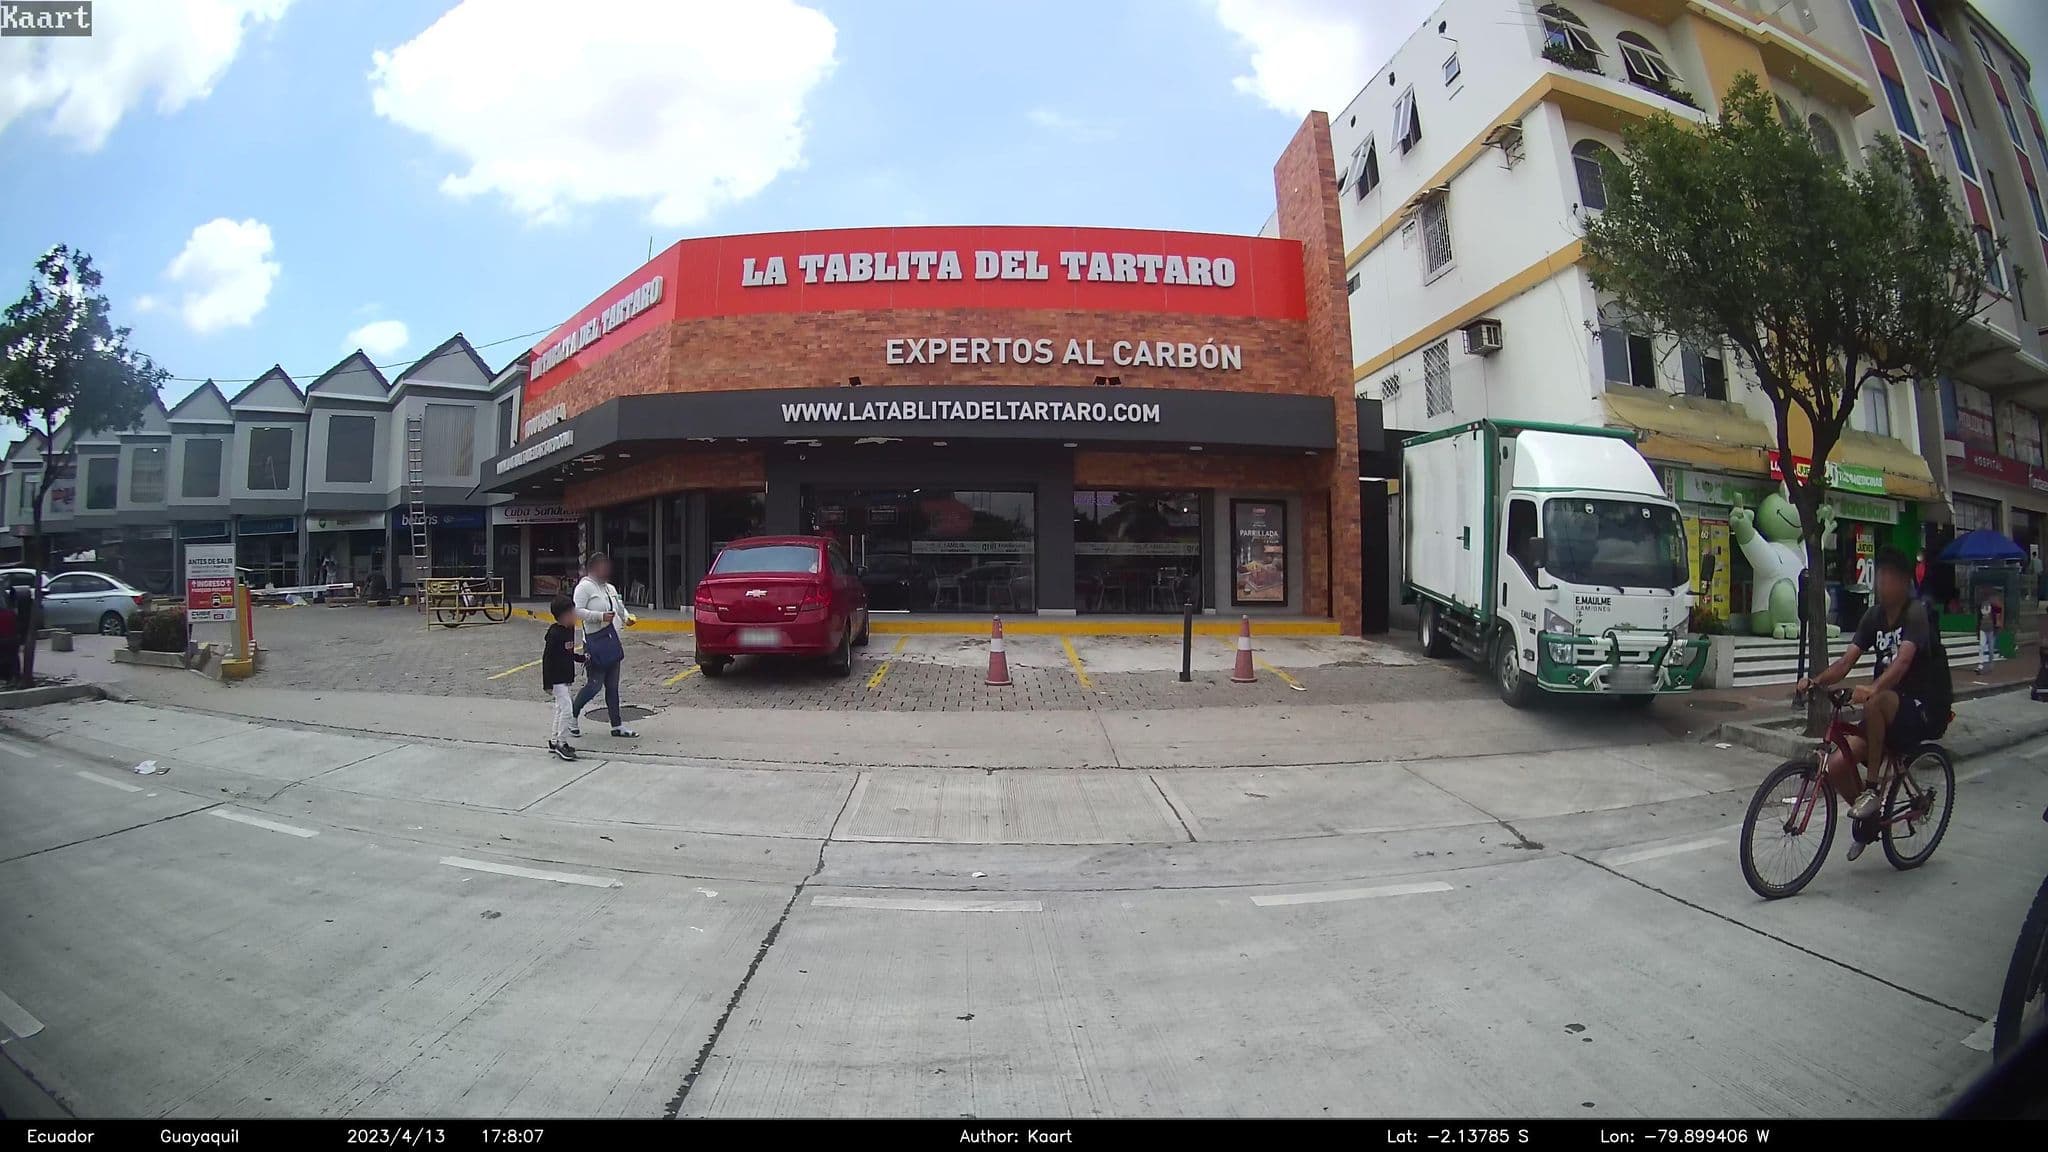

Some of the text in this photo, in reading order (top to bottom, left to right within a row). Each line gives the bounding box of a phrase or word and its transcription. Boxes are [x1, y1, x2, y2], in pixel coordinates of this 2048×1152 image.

[741, 250, 1236, 288] LA TABLITA DEL TARTARO
[886, 337, 1242, 371] EXPERTOS AL CARBÓN
[781, 401, 1161, 424] WWW.LATABLITADELTARTARO.COM
[504, 506, 529, 517] Cuba
[1240, 529, 1279, 537] PARRILLADA
[1575, 596, 1612, 606] E.MAULME
